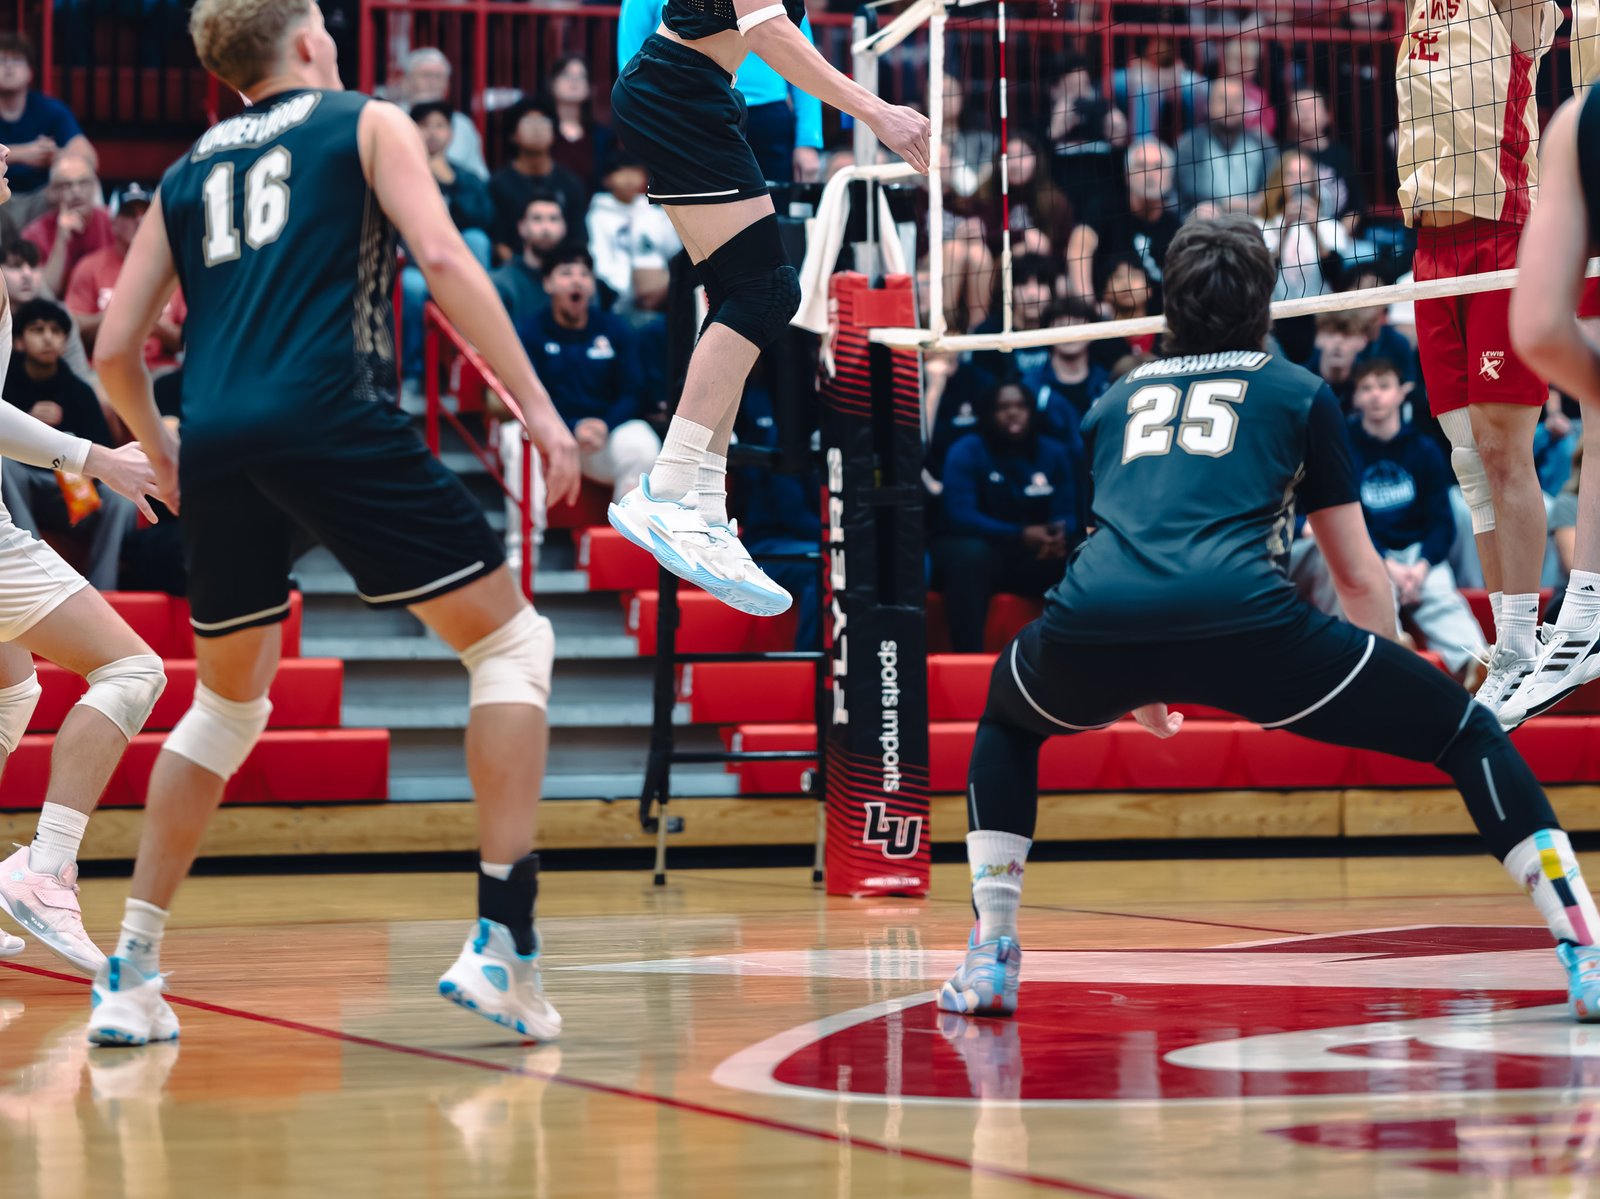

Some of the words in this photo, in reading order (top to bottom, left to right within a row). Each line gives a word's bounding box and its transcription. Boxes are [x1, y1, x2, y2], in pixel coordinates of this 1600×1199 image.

[202, 145, 292, 268] 16
[1121, 379, 1249, 465] 25
[827, 446, 849, 725] FLYERS
[877, 640, 901, 707] sports
[878, 709, 903, 792] imports
[863, 802, 923, 859] LU
